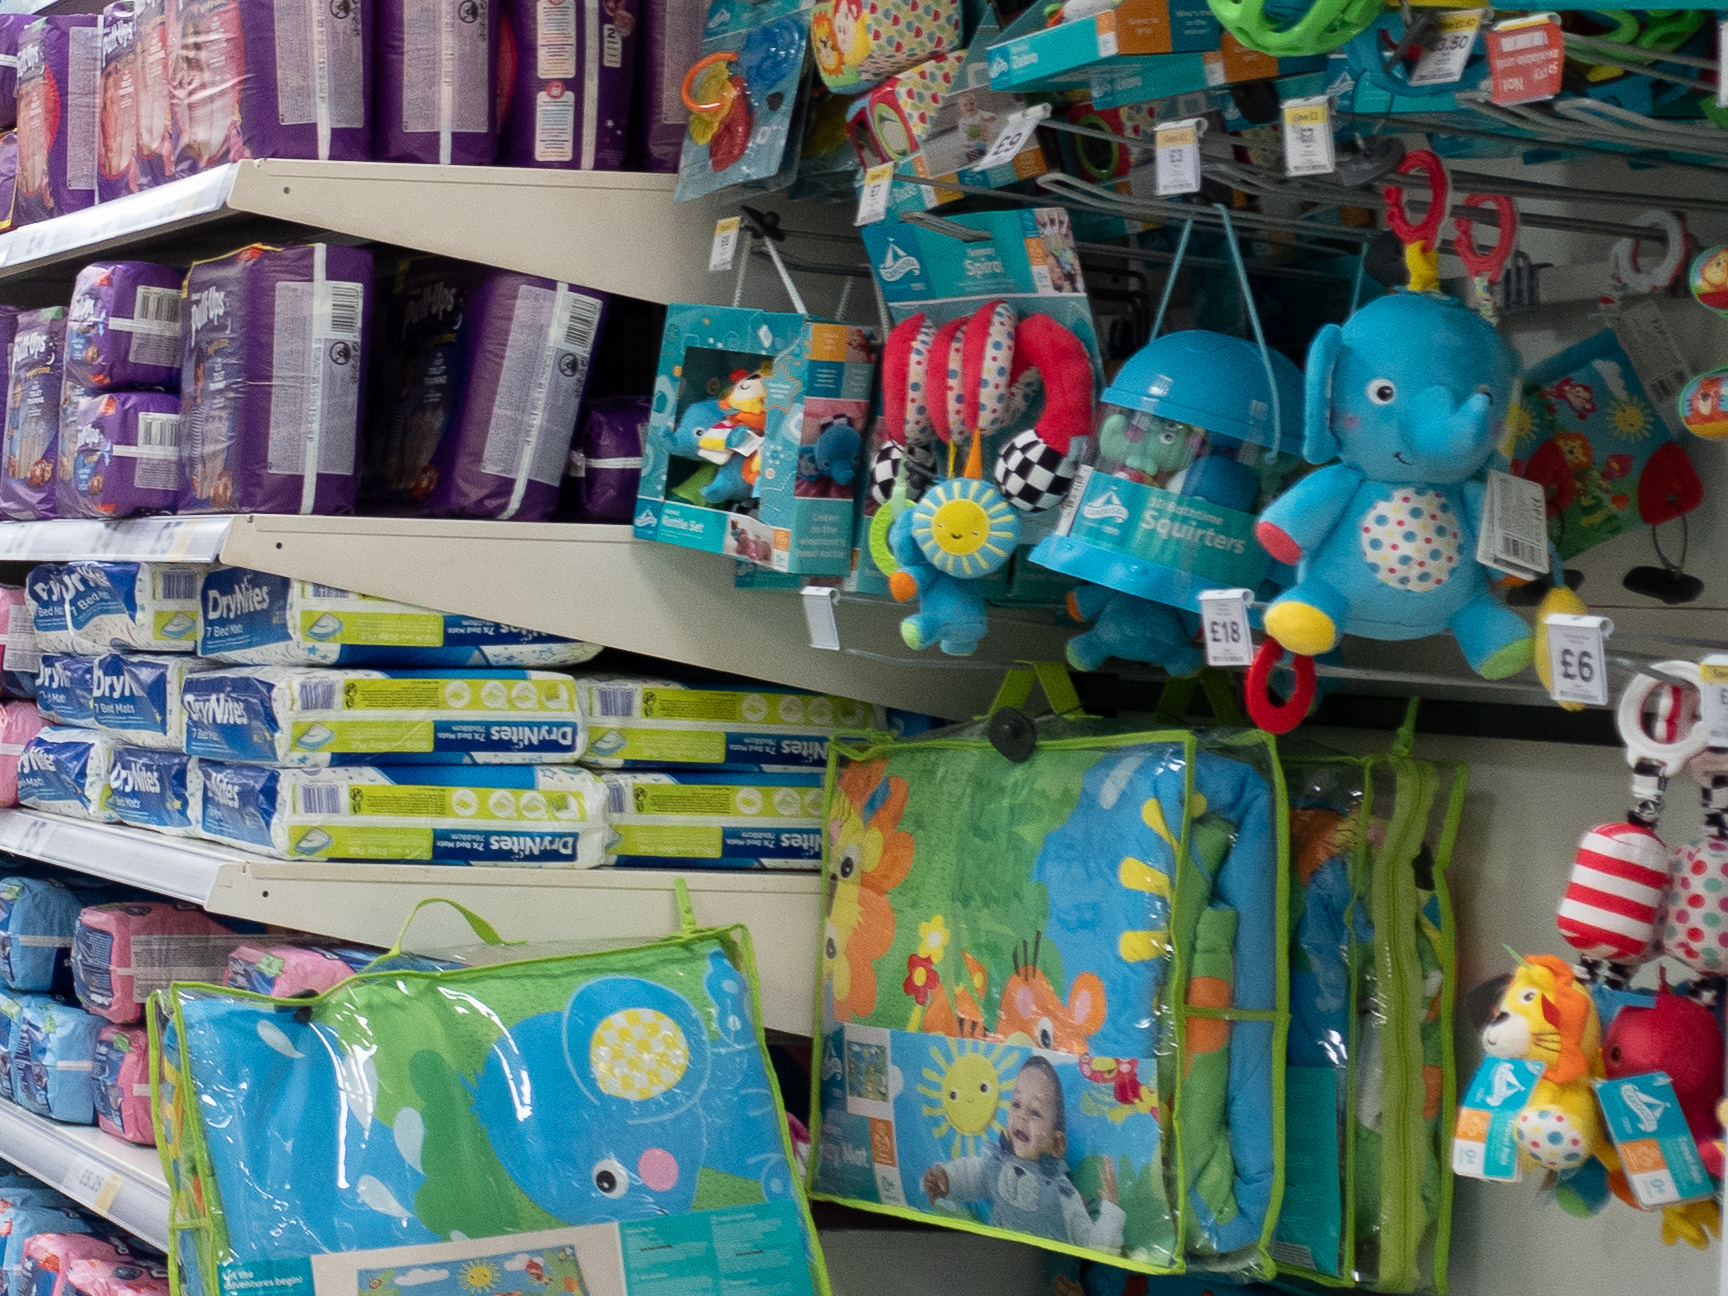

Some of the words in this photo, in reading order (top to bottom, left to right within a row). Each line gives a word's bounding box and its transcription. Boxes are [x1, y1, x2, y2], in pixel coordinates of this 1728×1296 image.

[1140, 509, 1246, 555] Squirters
[206, 584, 270, 621] DryNites
[213, 625, 229, 638] Bed
[1211, 621, 1241, 643] £18
[1561, 648, 1594, 683] £6
[116, 704, 135, 715] Mats
[490, 724, 574, 746] DryNites
[110, 761, 161, 794] DryNites
[489, 834, 574, 856] DryNites
